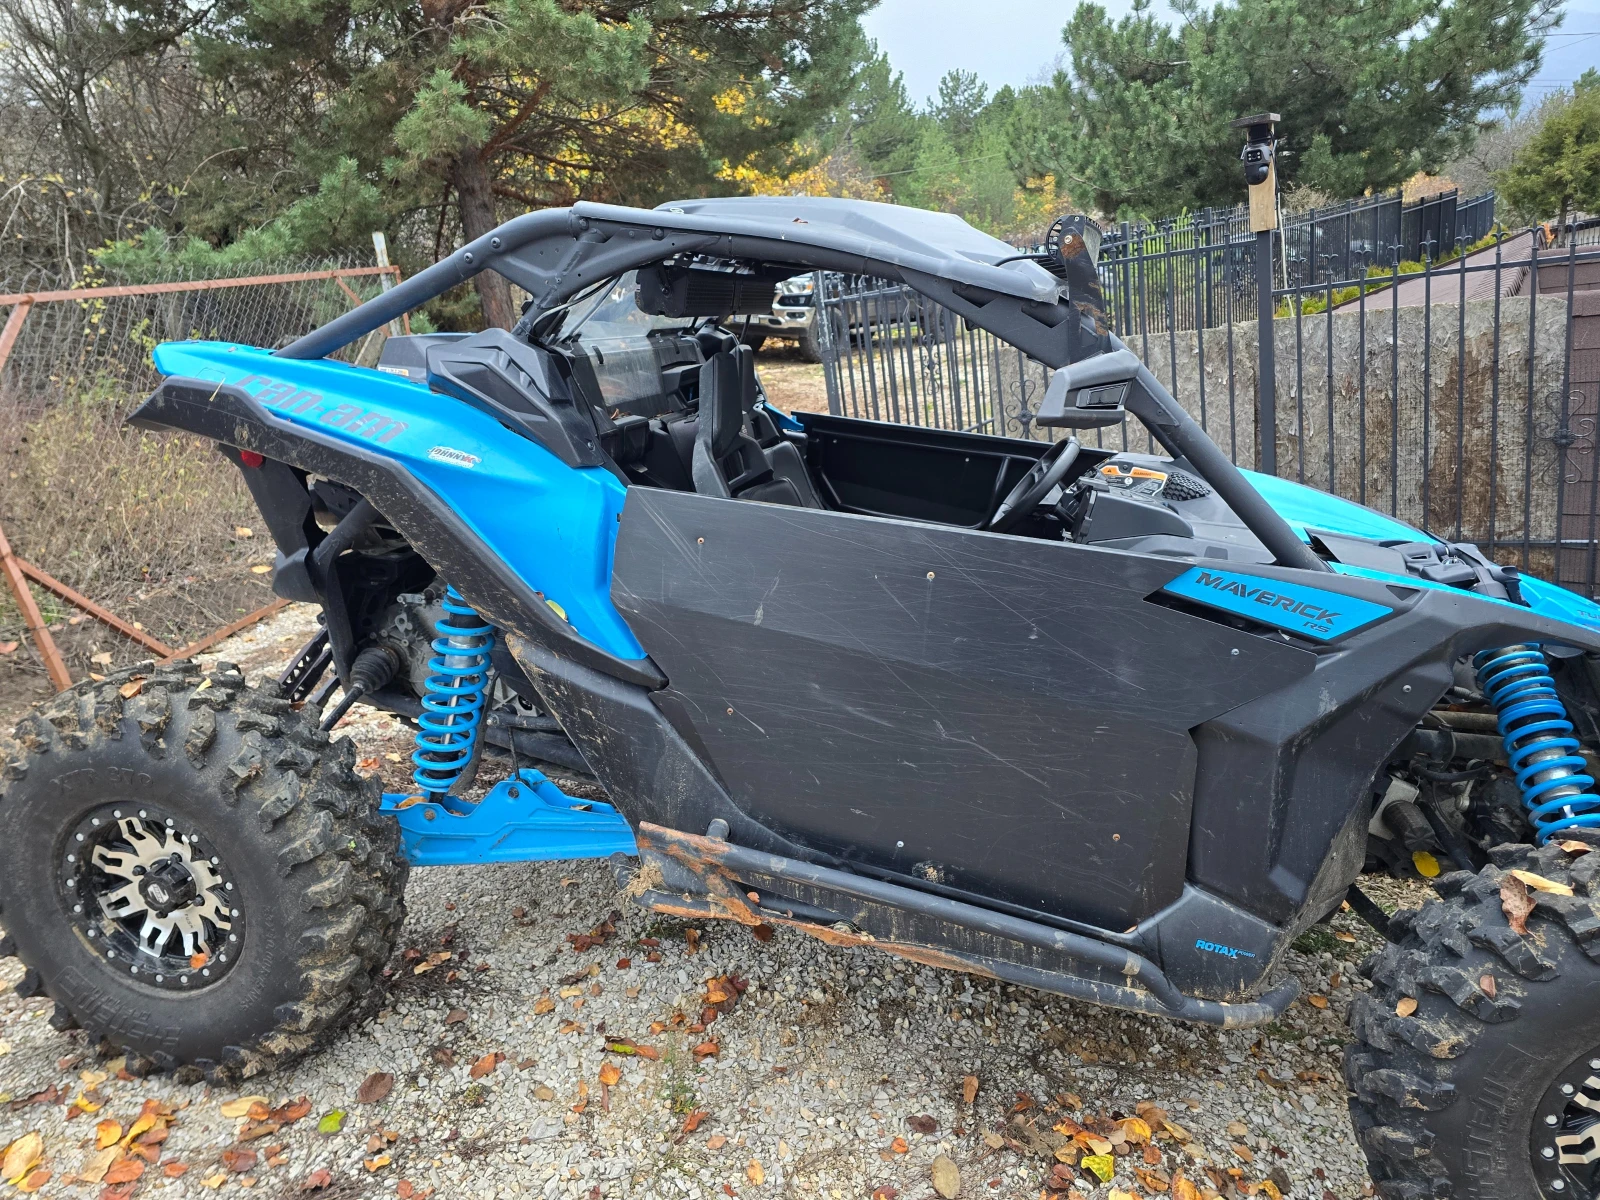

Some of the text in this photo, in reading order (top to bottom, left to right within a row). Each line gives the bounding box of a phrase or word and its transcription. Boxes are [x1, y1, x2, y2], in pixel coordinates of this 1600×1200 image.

[1196, 572, 1342, 626] MAVERICK
[1577, 610, 1600, 620] TU
[1303, 621, 1332, 633] RS
[1195, 939, 1238, 958] ROTAX
